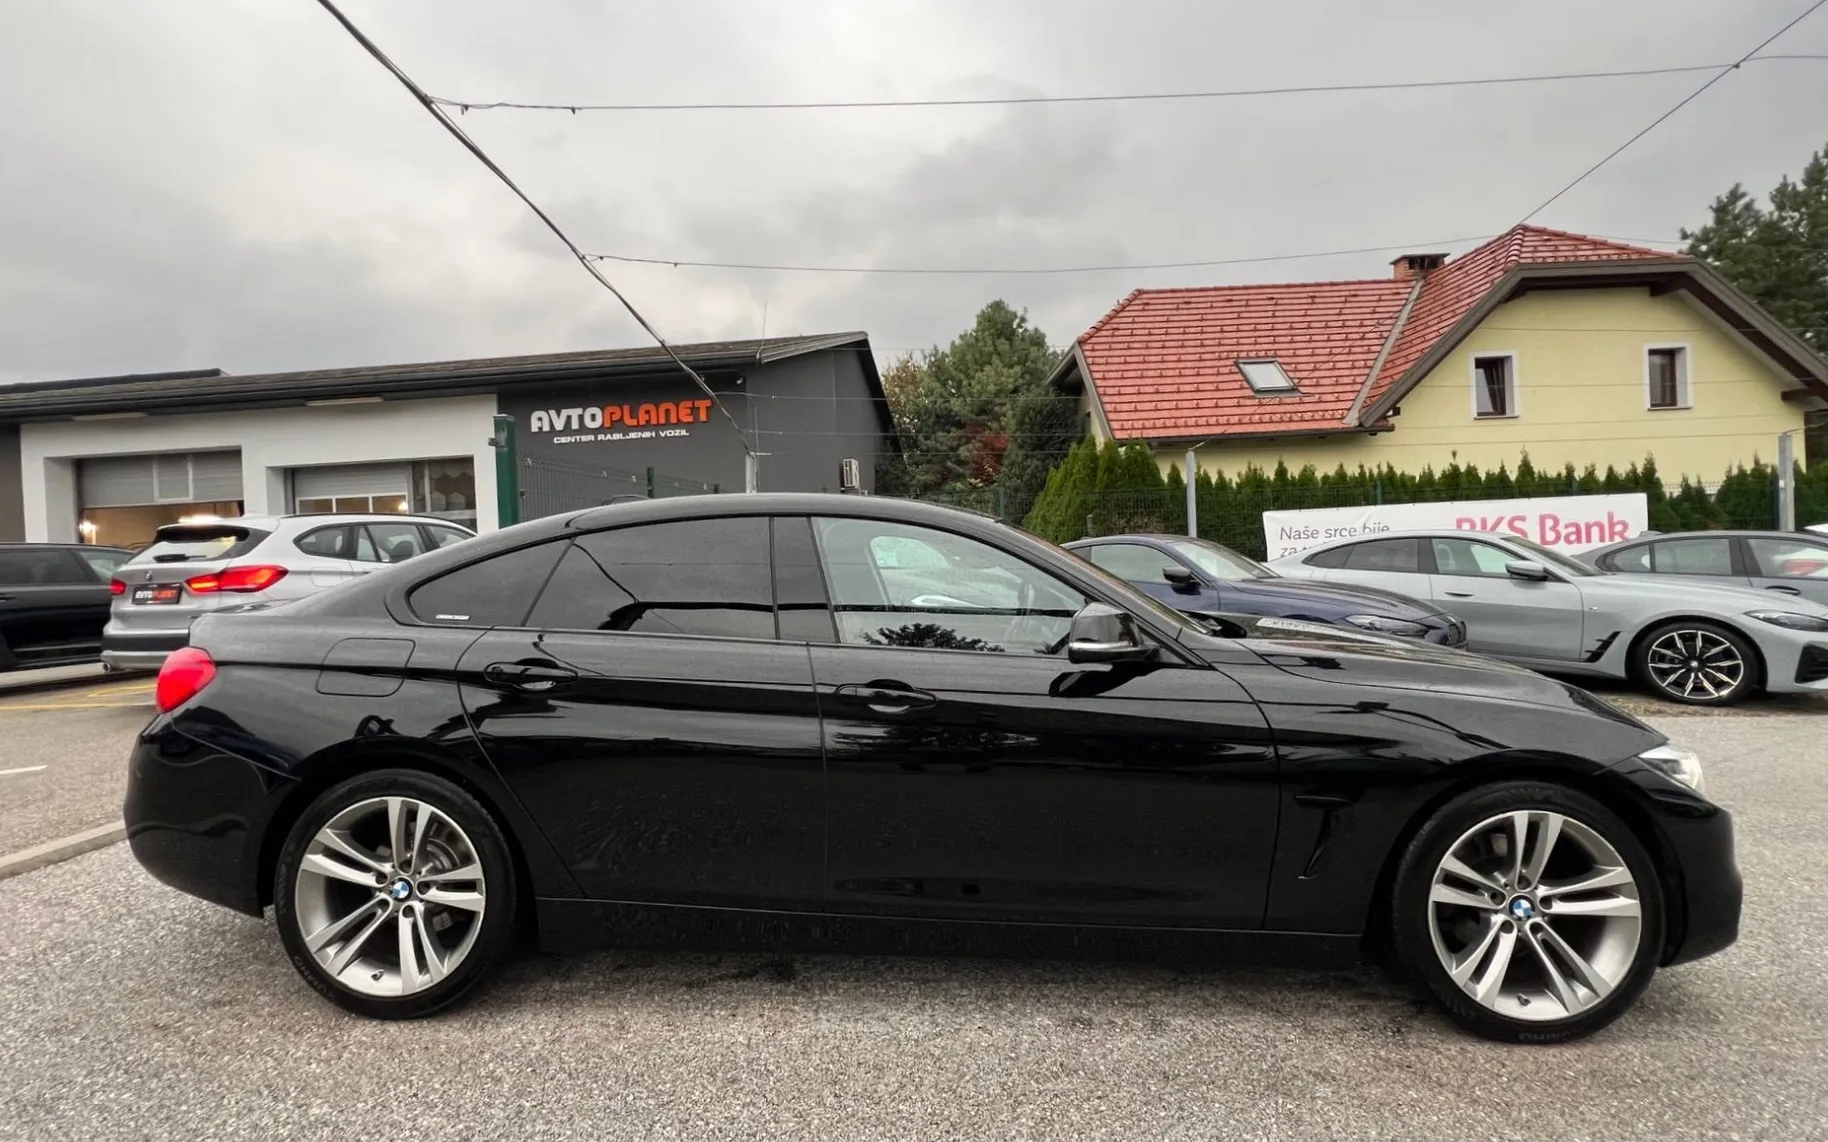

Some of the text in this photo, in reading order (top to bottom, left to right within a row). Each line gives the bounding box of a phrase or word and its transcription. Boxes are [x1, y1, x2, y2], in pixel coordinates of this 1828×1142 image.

[530, 400, 712, 433] AVTOPLANET
[553, 429, 690, 444] CENTER RABLJENIH VOZIL
[1280, 526, 1320, 541] Naše
[1324, 526, 1357, 539] srce
[1538, 511, 1630, 546] Bank
